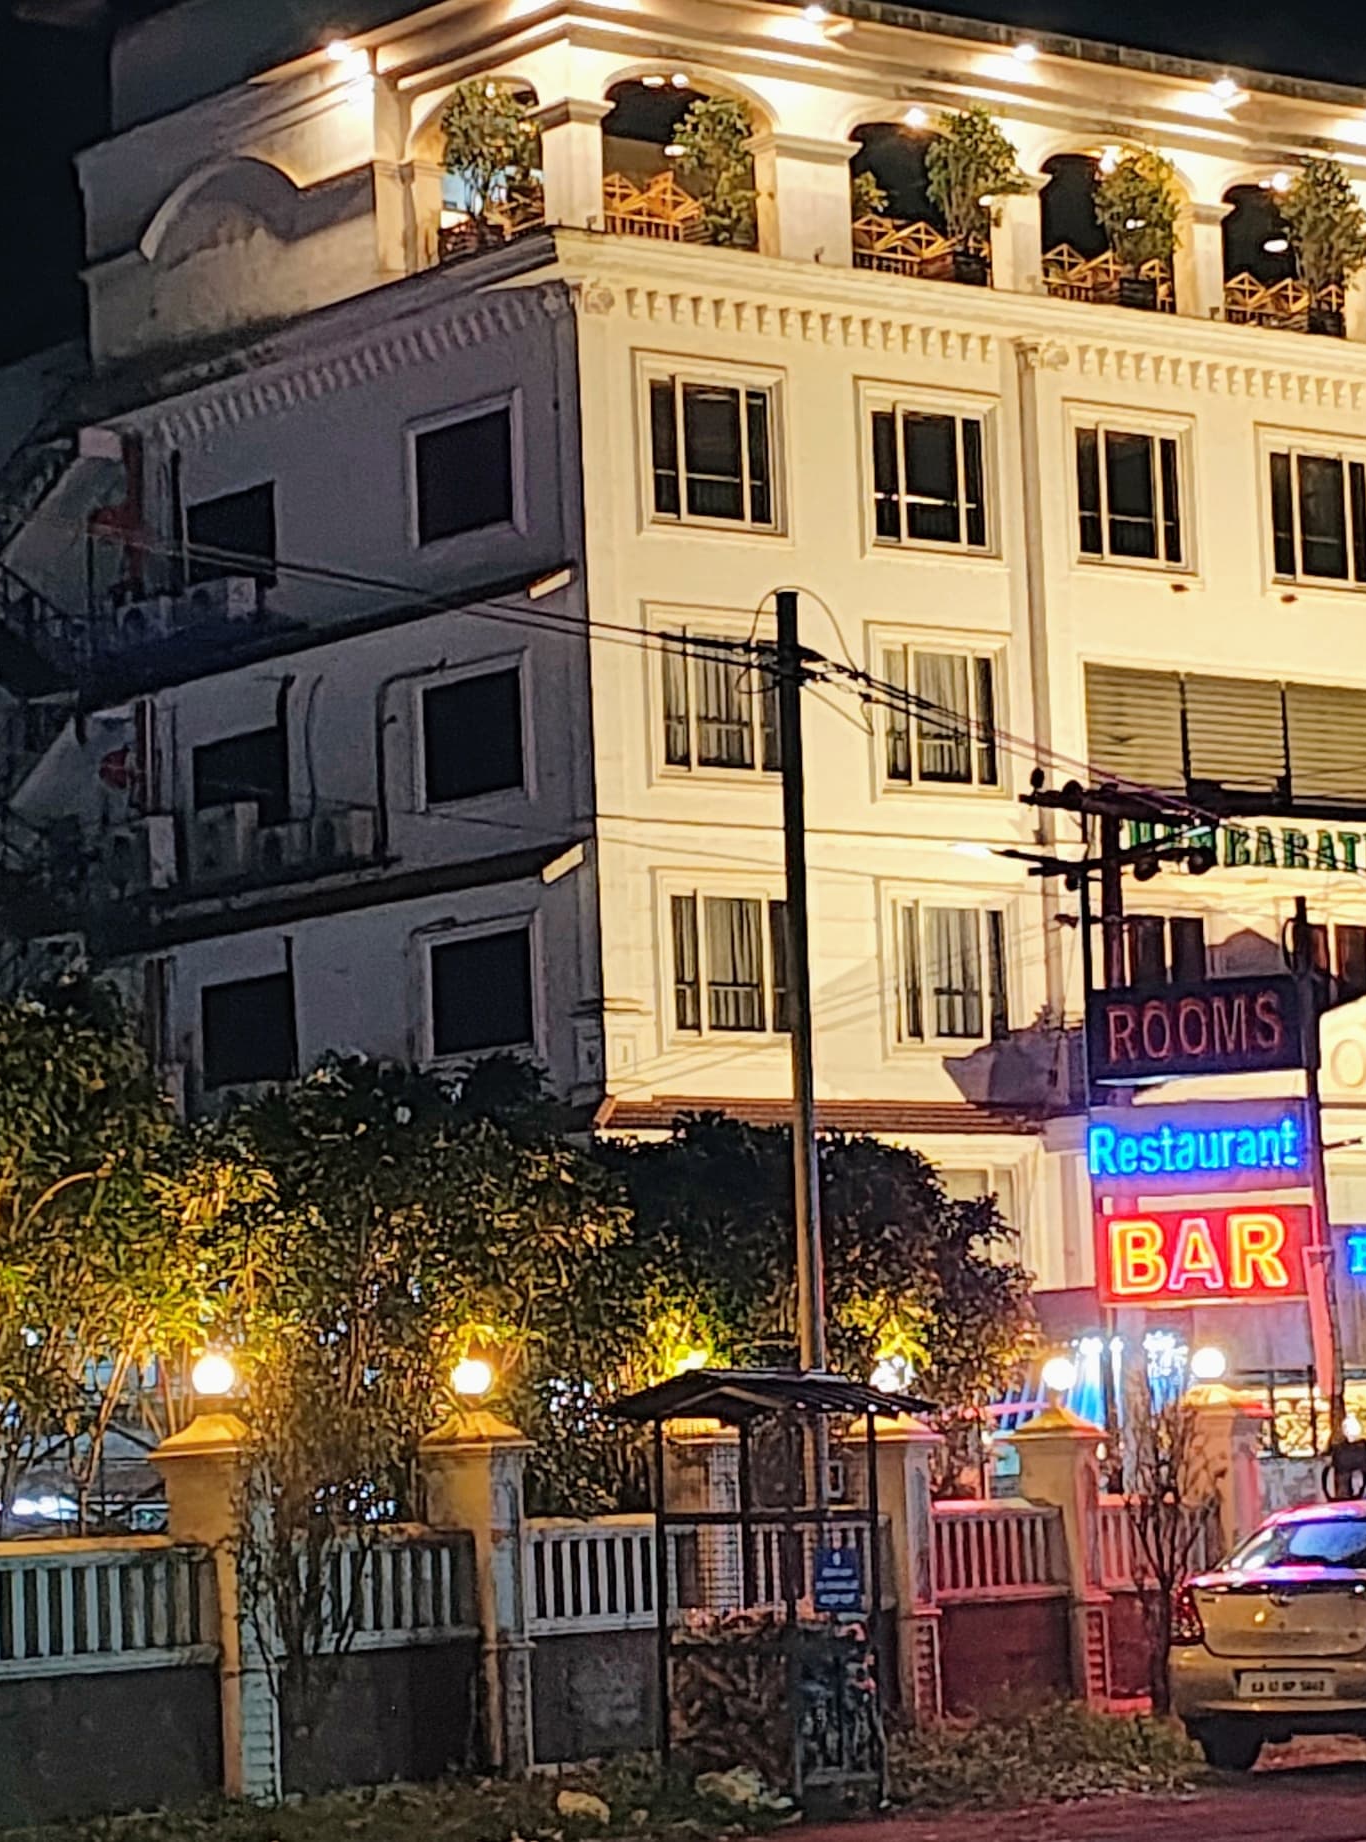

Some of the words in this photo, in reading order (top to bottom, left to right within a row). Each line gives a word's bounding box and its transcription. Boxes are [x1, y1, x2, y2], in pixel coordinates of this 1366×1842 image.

[1106, 990, 1284, 1064] ROOMS
[1089, 1117, 1298, 1174] Restaurant
[1108, 1213, 1288, 1295] BAR
